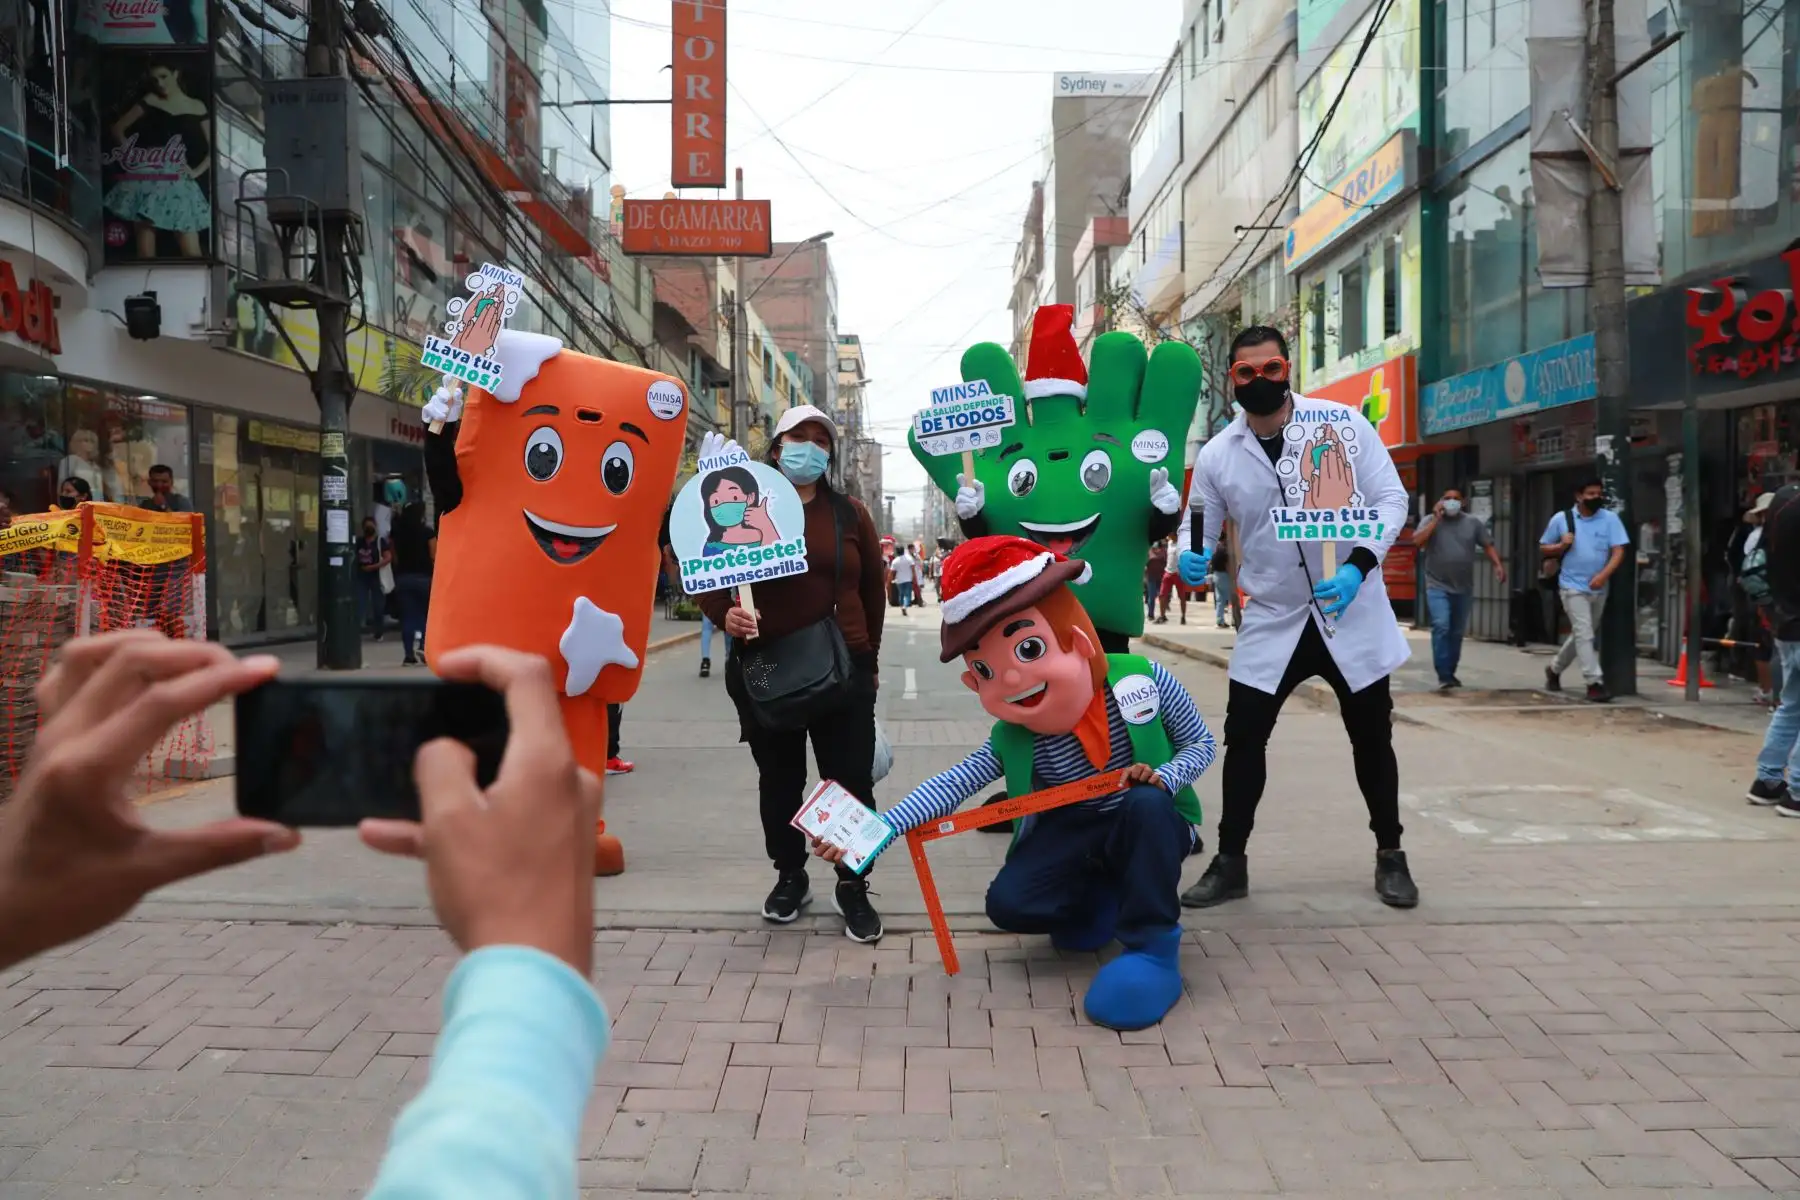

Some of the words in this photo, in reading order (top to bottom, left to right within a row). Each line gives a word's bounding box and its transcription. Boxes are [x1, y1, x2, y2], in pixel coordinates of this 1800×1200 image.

[684, 0, 715, 177] TORRE
[1060, 76, 1107, 93] Sydney
[628, 204, 656, 229] DE
[660, 204, 765, 232] GAMARRA
[669, 235, 712, 247] BAZO
[481, 264, 523, 288] MINSA
[426, 337, 471, 364] ¡Lava
[473, 356, 502, 375] tus
[423, 351, 501, 391] manos!
[649, 391, 682, 405] MINSA
[932, 382, 989, 405] MINSA
[920, 411, 931, 419] LA
[933, 404, 961, 416] SALUD
[963, 397, 1005, 411] DEPENDE
[1295, 410, 1351, 422] MINSA
[921, 417, 944, 433] DE
[946, 406, 1006, 429] TODOS
[1133, 440, 1167, 449] MINSA
[700, 452, 748, 471] MINSA
[1272, 509, 1335, 523] ¡Lava
[1341, 508, 1379, 521] tus
[0, 523, 49, 541] ELIGRO
[0, 533, 49, 552] ECTRICOS
[1278, 523, 1384, 540] manos!
[682, 539, 804, 577] ¡Protégete!
[685, 578, 717, 592] Usa
[720, 559, 805, 586] mascarilla
[1117, 684, 1157, 707] MINSA
